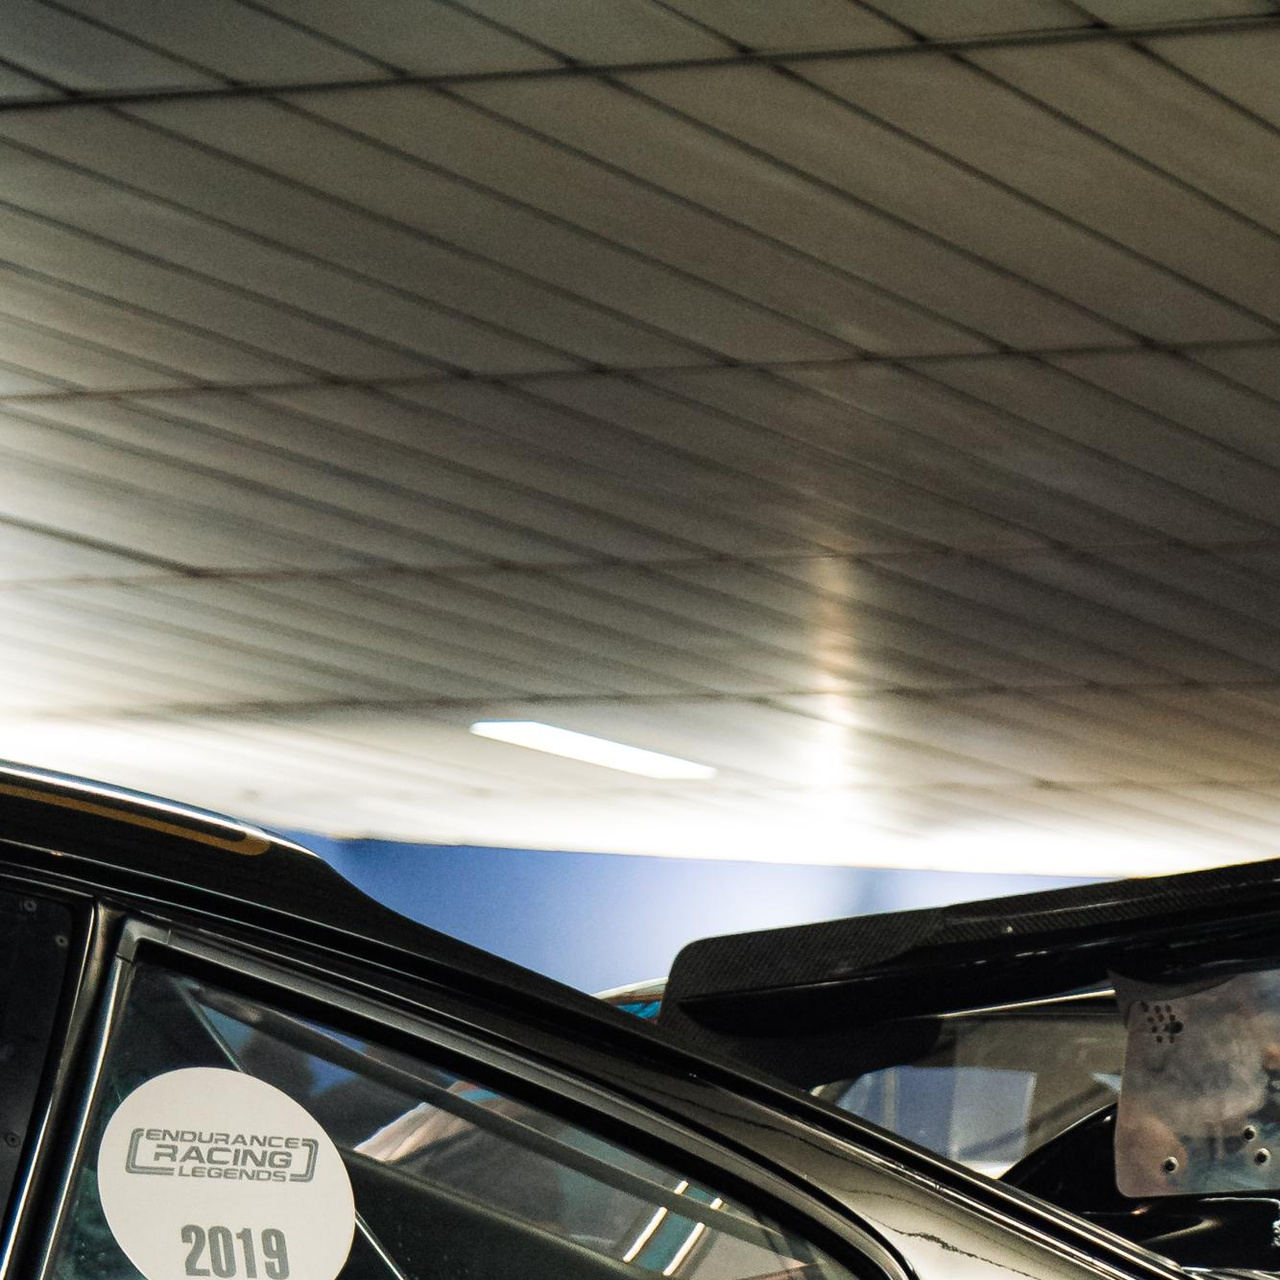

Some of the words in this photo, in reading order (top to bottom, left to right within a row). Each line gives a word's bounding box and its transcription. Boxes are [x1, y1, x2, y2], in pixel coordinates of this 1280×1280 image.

[146, 1128, 300, 1149] ENDURANCE
[153, 1143, 293, 1169] RACING
[178, 1165, 287, 1183] LEGENDS
[180, 1224, 290, 1280] 2019
